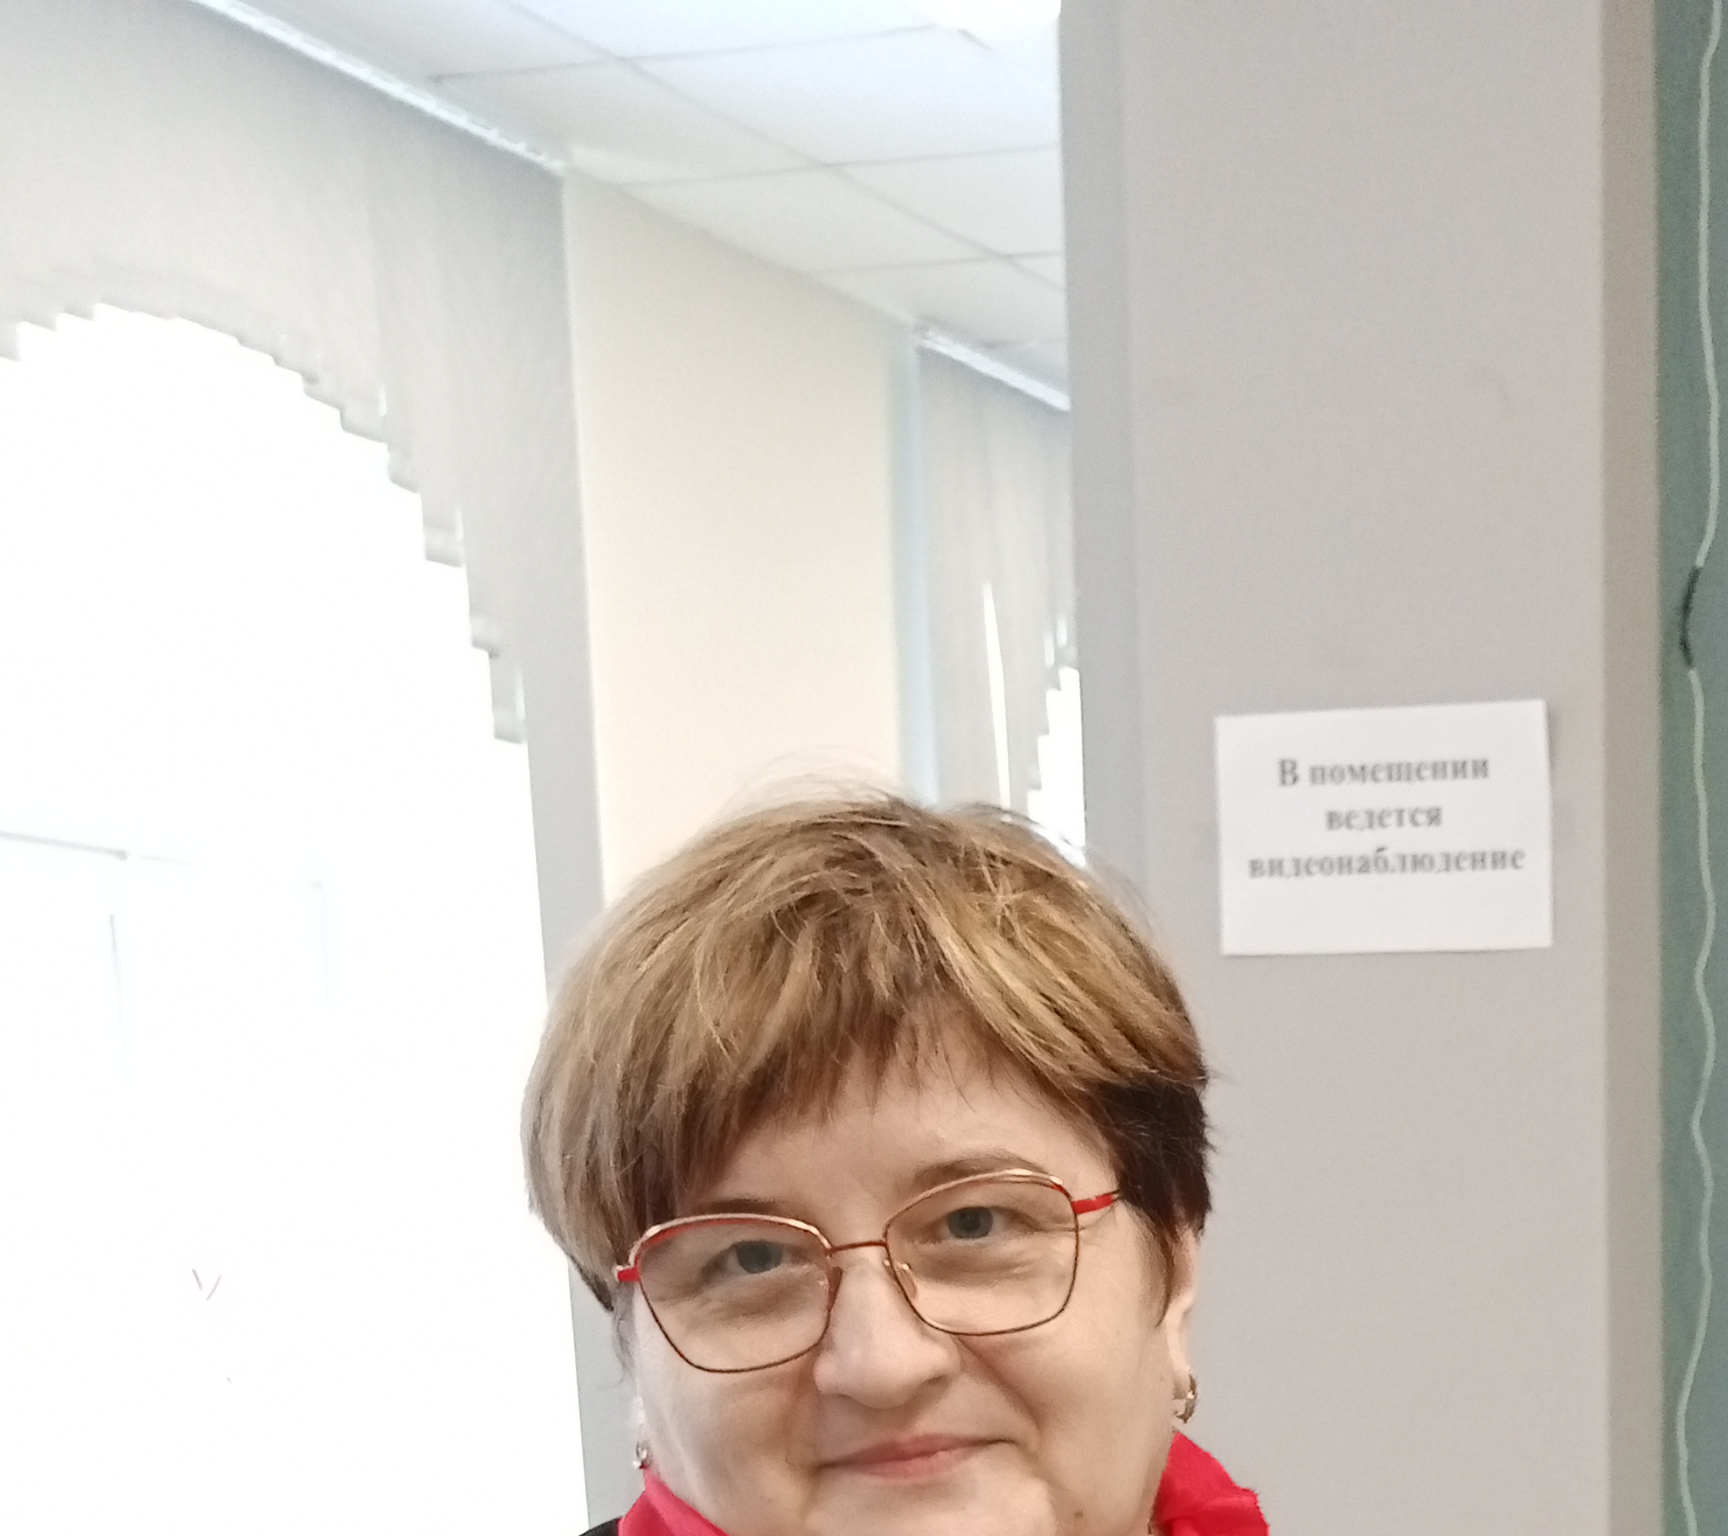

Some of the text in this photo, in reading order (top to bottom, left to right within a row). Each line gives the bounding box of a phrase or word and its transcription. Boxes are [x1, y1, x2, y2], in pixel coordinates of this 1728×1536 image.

[1278, 757, 1490, 787] В помещении
[1325, 806, 1443, 832] ведется
[1248, 846, 1526, 879] видеонаблюдение
